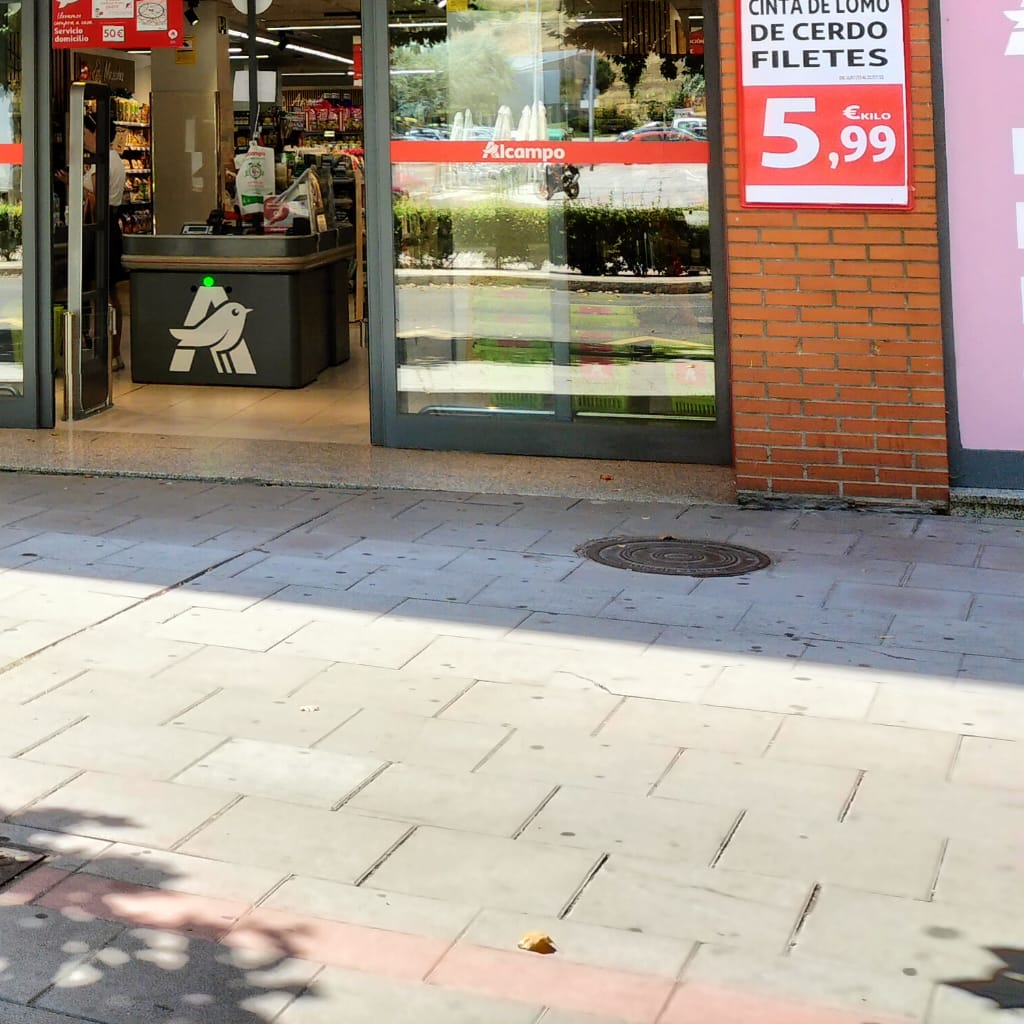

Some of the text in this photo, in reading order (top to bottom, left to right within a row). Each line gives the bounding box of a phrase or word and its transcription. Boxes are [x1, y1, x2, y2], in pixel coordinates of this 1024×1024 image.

[54, 35, 88, 43] domicilio
[104, 29, 123, 37] 50 €
[750, 21, 888, 42] DE CERDO
[752, 48, 889, 69] FILETES
[482, 142, 566, 162] Alcampo
